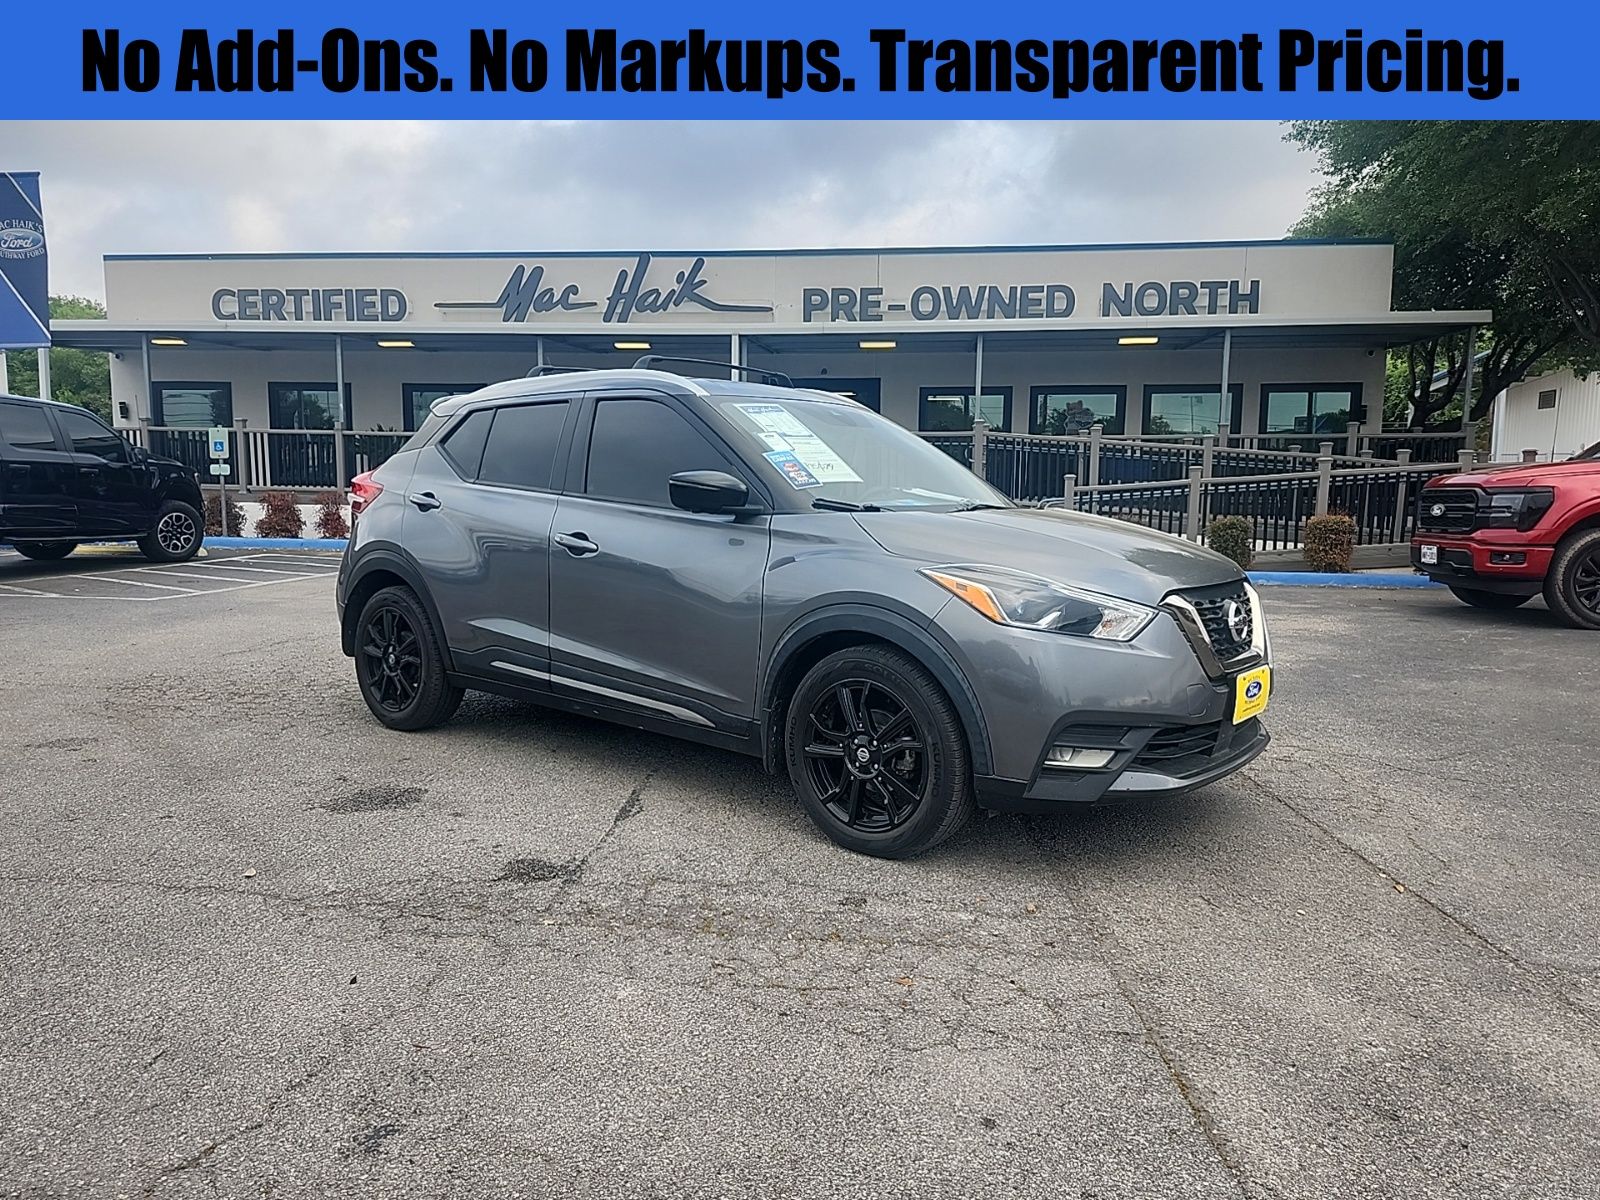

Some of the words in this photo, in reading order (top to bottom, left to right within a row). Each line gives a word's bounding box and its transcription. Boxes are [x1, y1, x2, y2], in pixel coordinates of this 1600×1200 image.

[0, 220, 10, 229] AC
[12, 219, 43, 233] HAIK'S
[1, 232, 33, 248] Ford
[27, 248, 45, 259] FORD
[212, 287, 407, 321] CERTIFIED
[434, 264, 597, 323] Mac
[601, 252, 774, 323] Haik
[802, 283, 1076, 322] PRE-OWNED
[1101, 279, 1261, 317] NORTH
[789, 716, 797, 767] KUMHO
